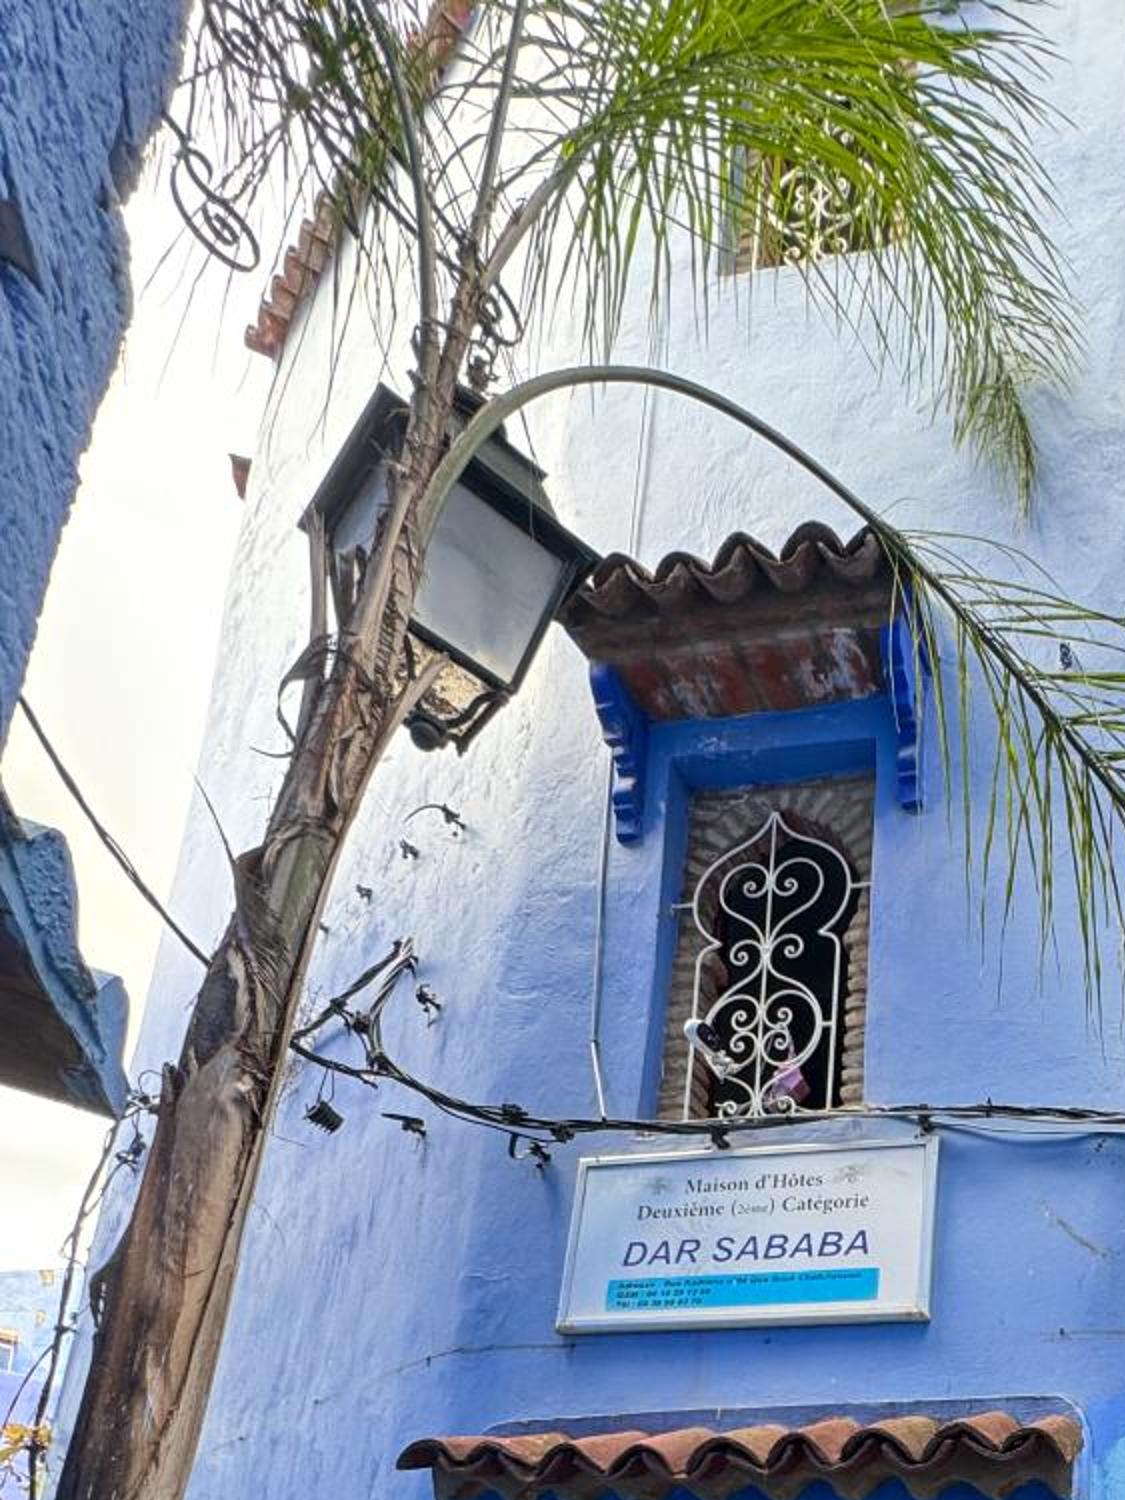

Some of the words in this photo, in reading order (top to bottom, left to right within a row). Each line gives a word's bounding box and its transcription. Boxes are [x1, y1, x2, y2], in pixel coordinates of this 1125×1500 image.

[685, 1179, 749, 1194] Maison
[755, 1173, 824, 1190] d'Hôtes
[782, 1193, 870, 1213] Catégorie
[622, 1239, 702, 1266] DAR
[712, 1229, 870, 1262] SABABA
